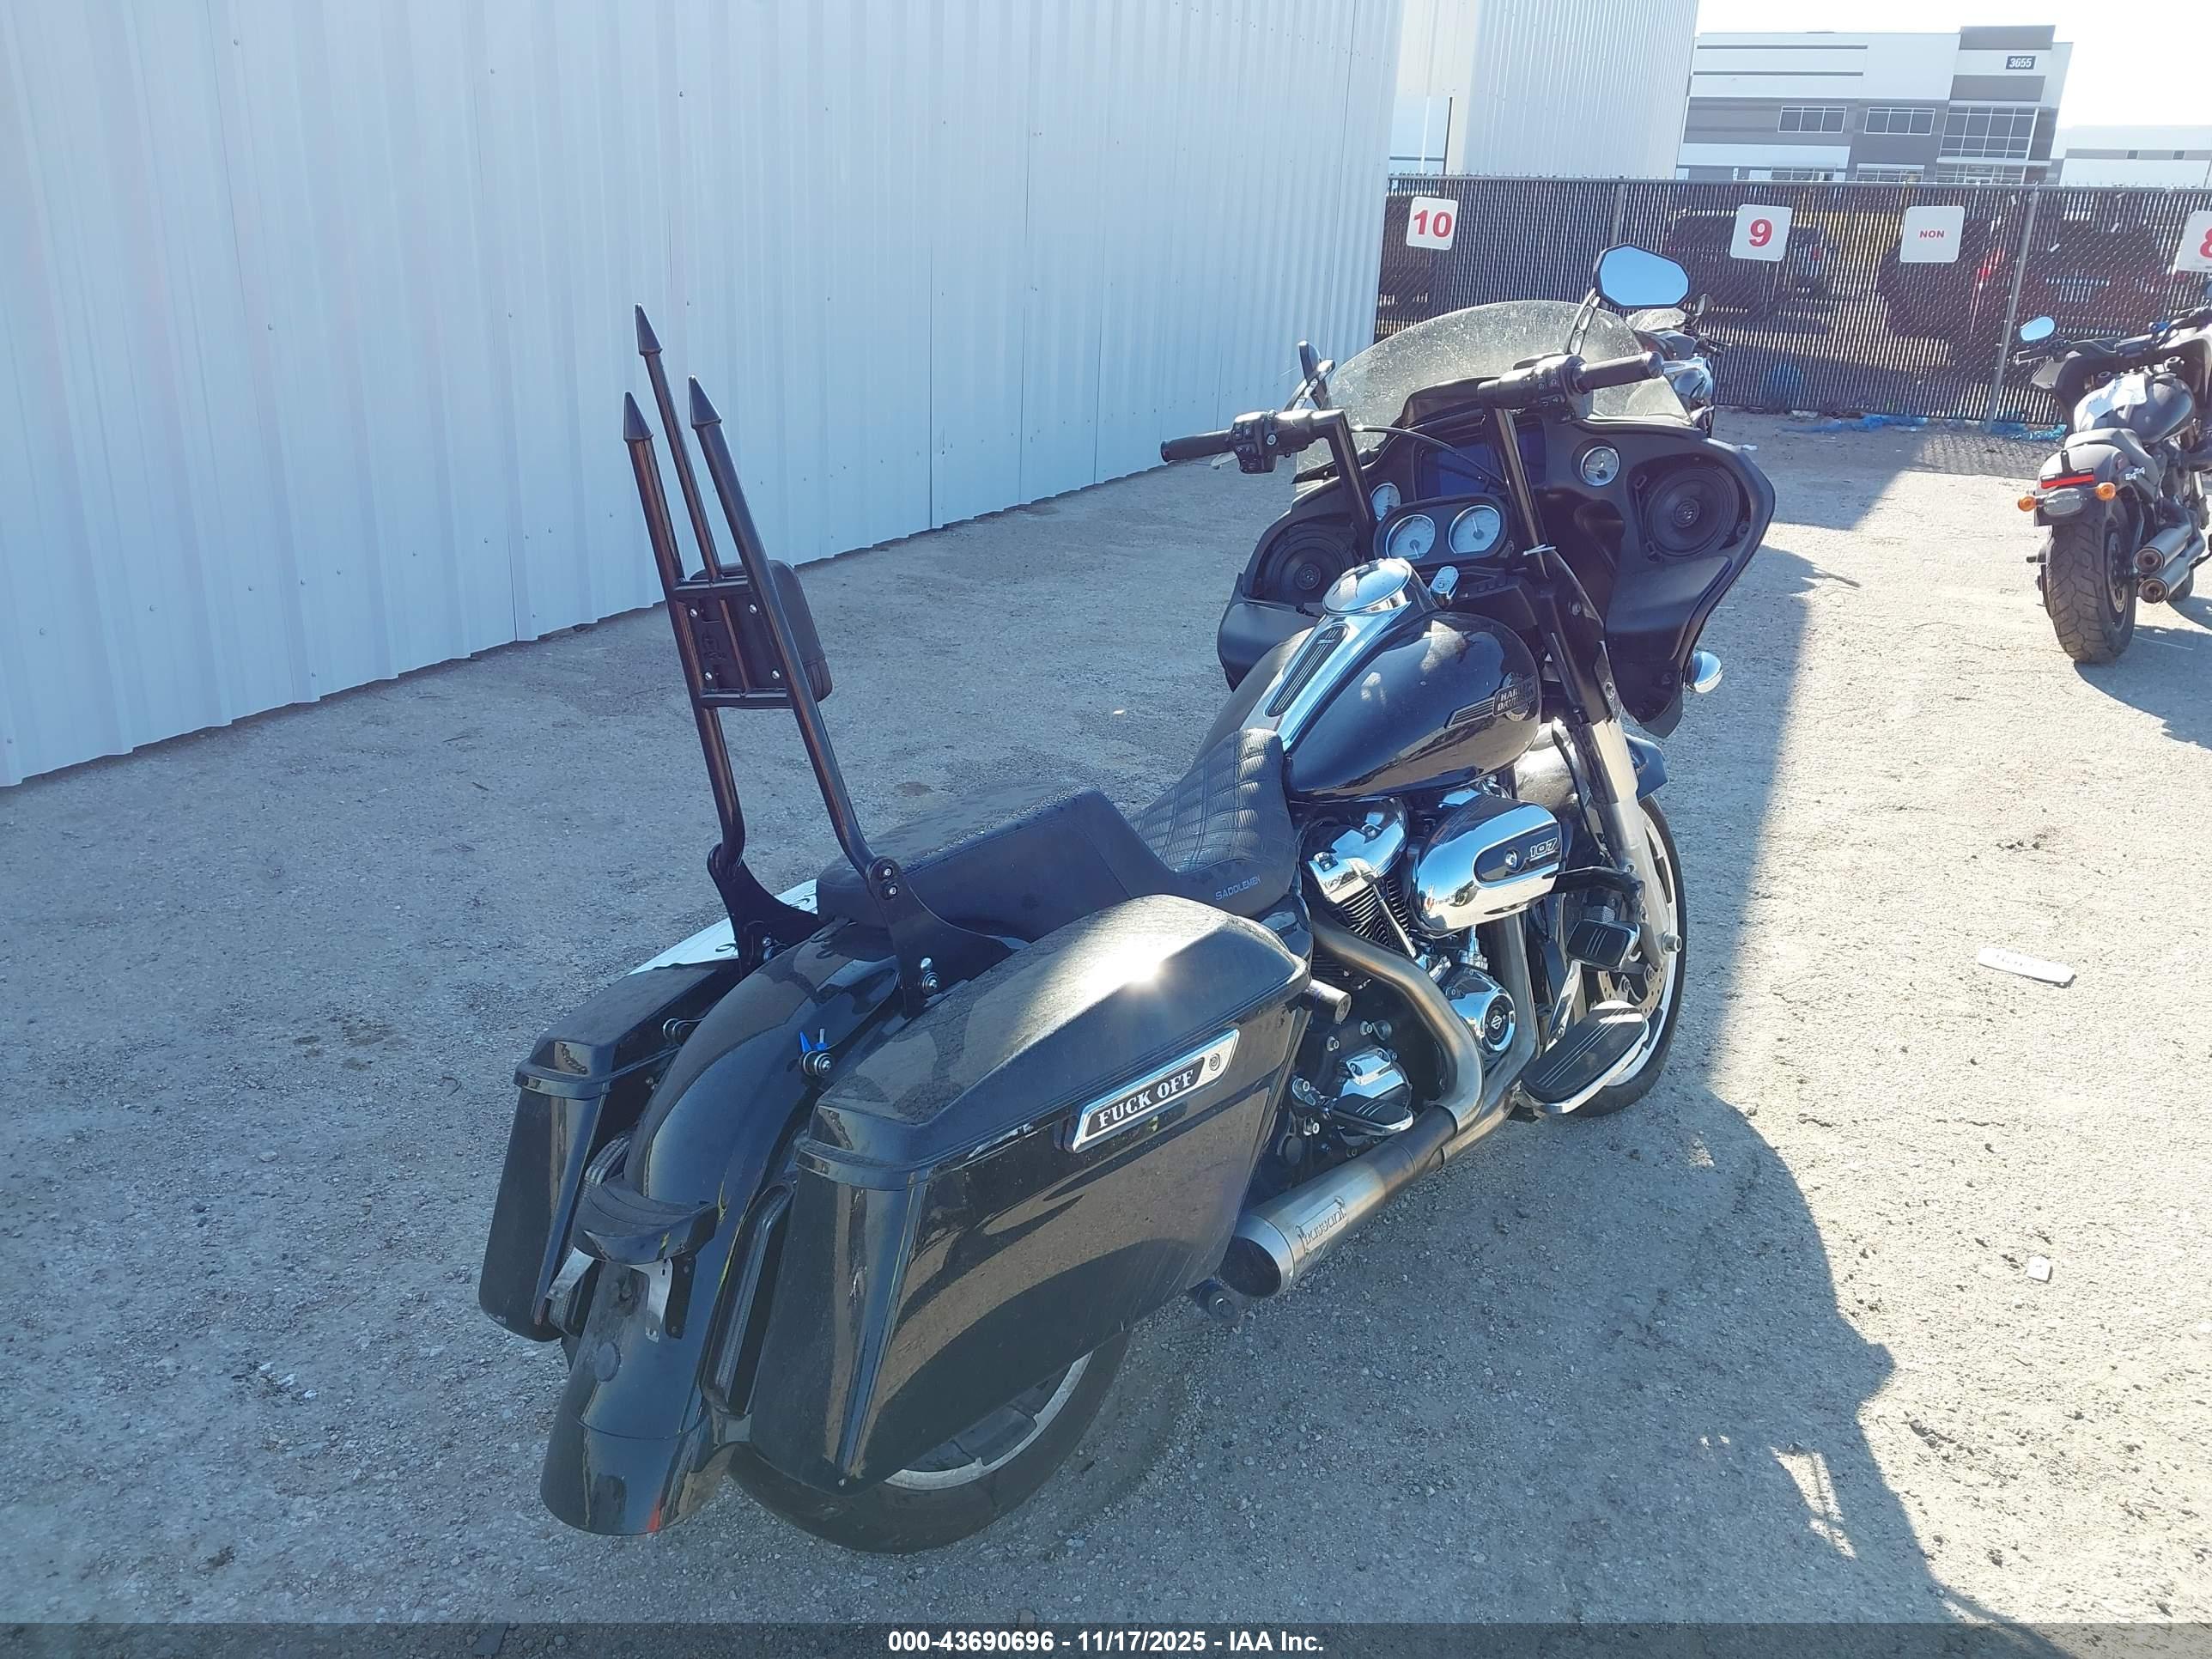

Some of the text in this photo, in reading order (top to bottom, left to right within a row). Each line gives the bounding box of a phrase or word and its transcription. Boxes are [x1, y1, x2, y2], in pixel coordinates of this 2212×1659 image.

[2009, 58, 2033, 68] 3655
[1413, 210, 1452, 238] 10
[1748, 218, 1773, 246] 9
[1918, 229, 1945, 239] NON
[1530, 837, 1558, 858] 107
[1097, 1069, 1194, 1128] FUCK OFF
